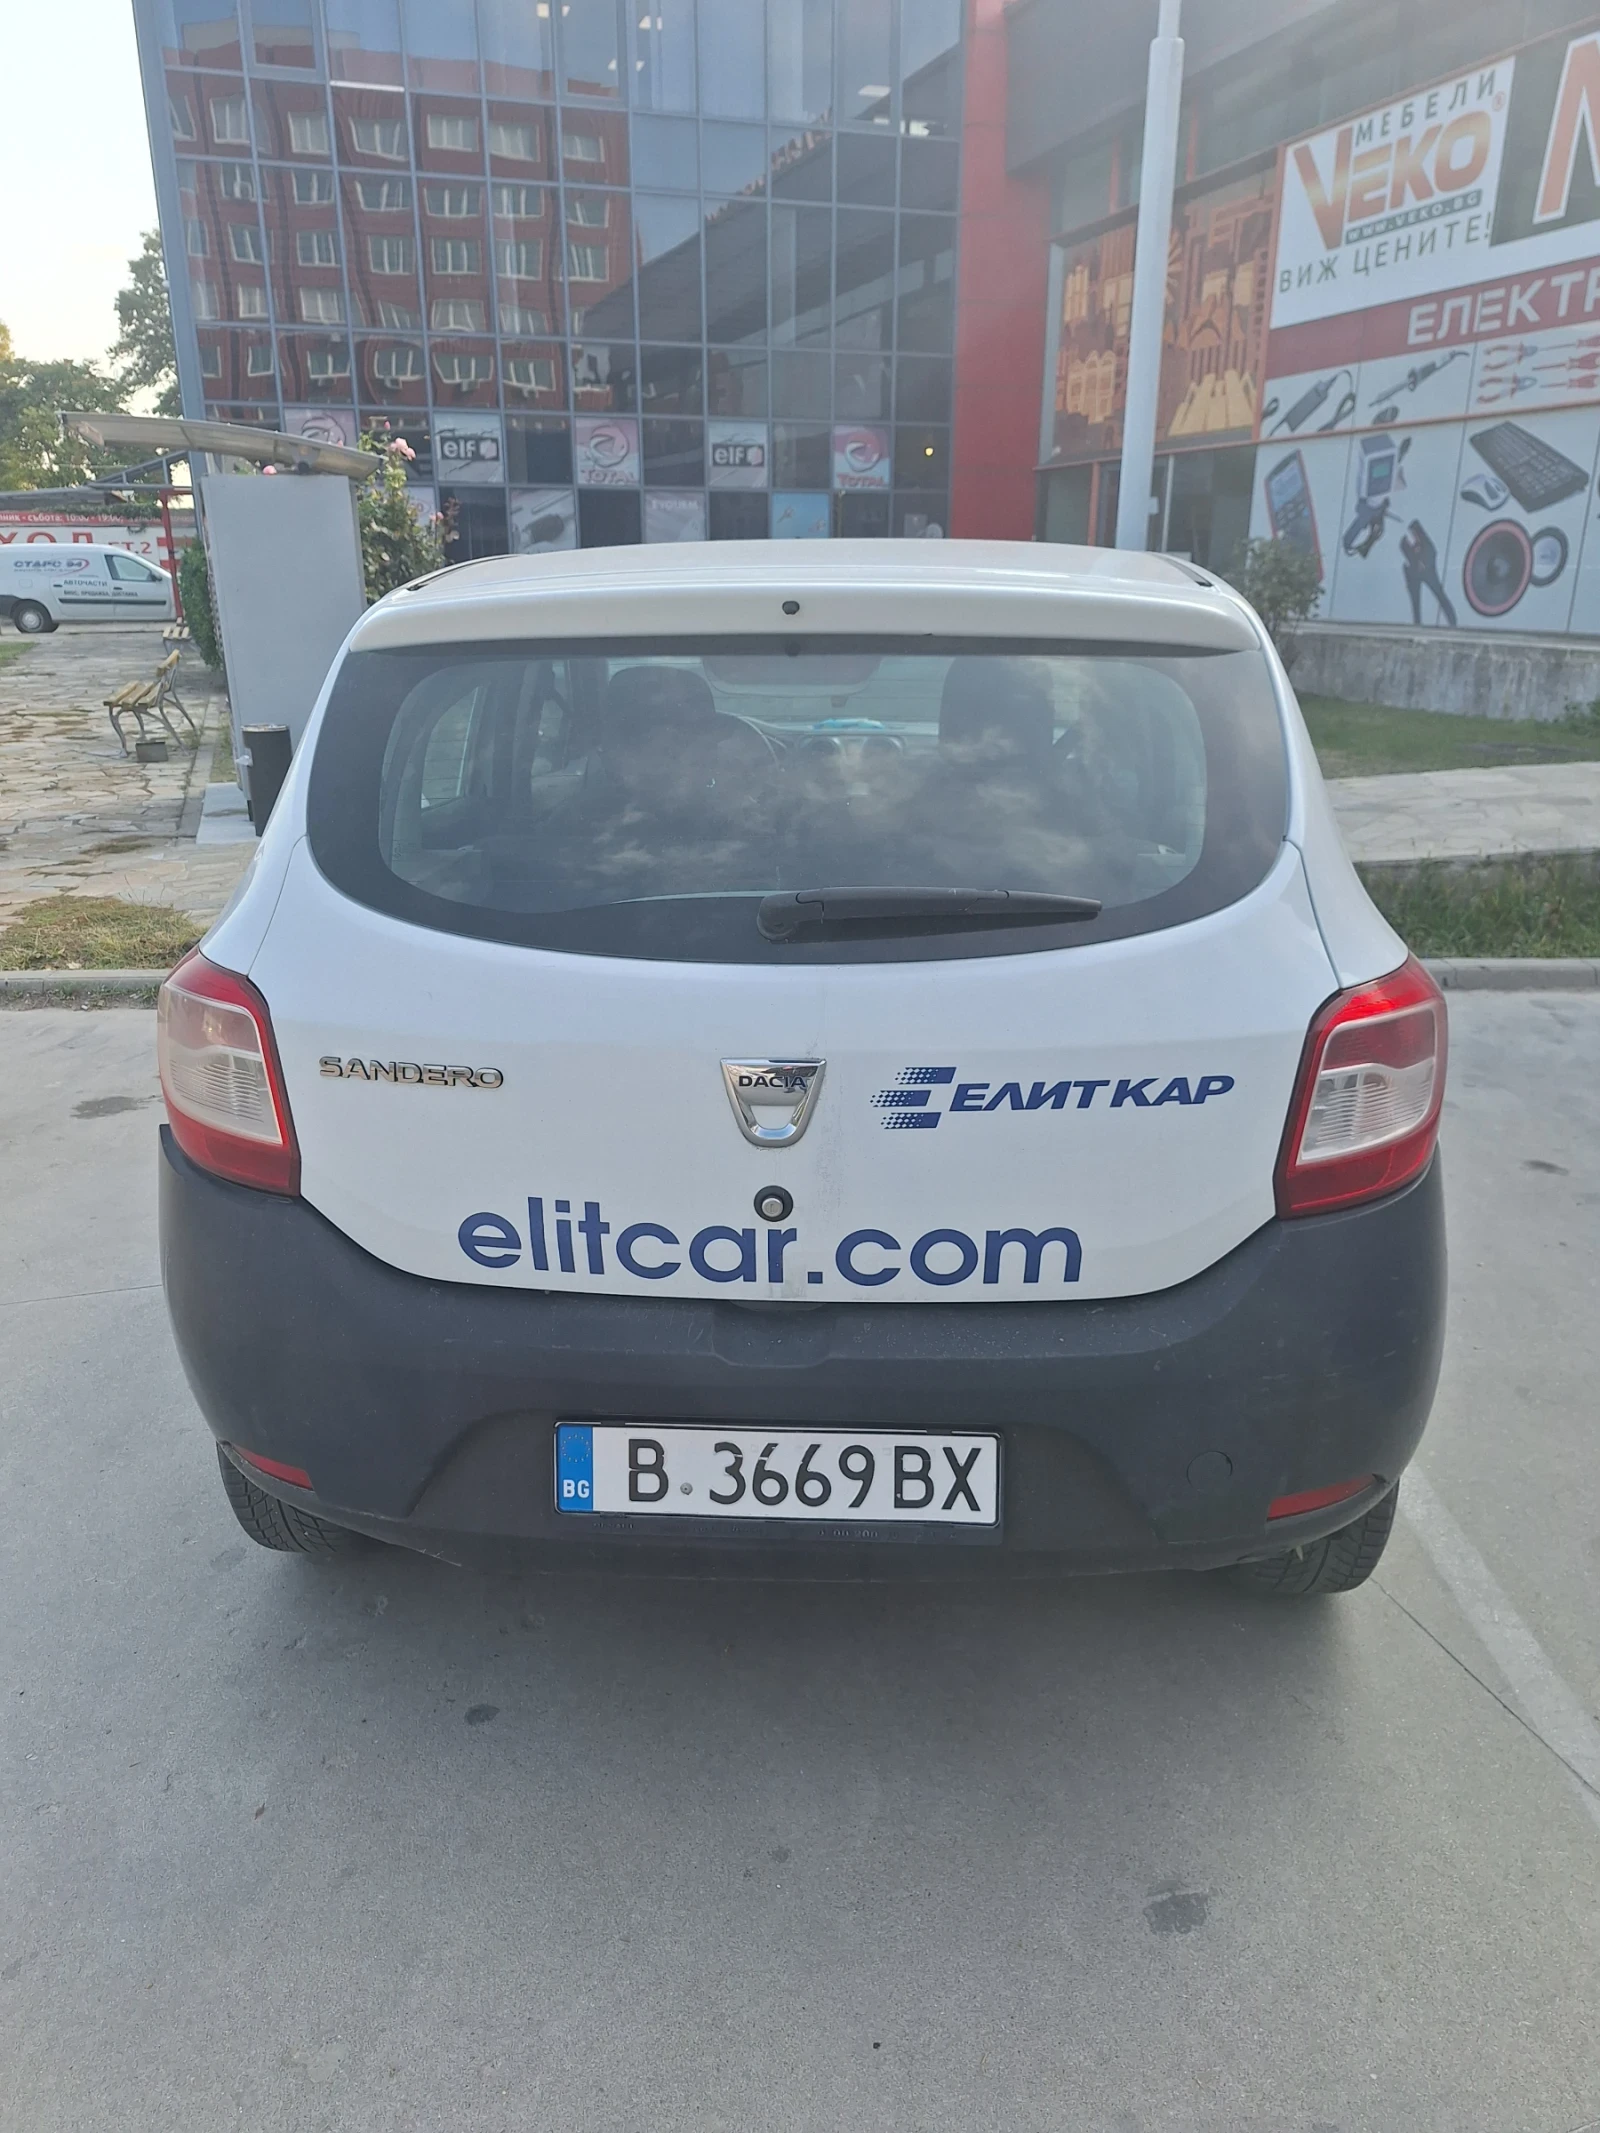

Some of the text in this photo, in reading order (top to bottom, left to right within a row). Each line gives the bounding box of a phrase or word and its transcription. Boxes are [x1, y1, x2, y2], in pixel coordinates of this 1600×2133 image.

[1355, 69, 1496, 147] МЕБЕЛИ
[1293, 110, 1491, 251] VEKO
[1279, 212, 1492, 293] ВИЖ ЦЕНИТЕ!
[443, 438, 476, 459] elf
[714, 445, 748, 465] elf
[319, 1056, 504, 1089] SANDERO
[739, 1076, 806, 1088] DACIA
[458, 1196, 1083, 1287] elitcar.com
[563, 1480, 590, 1499] BG
